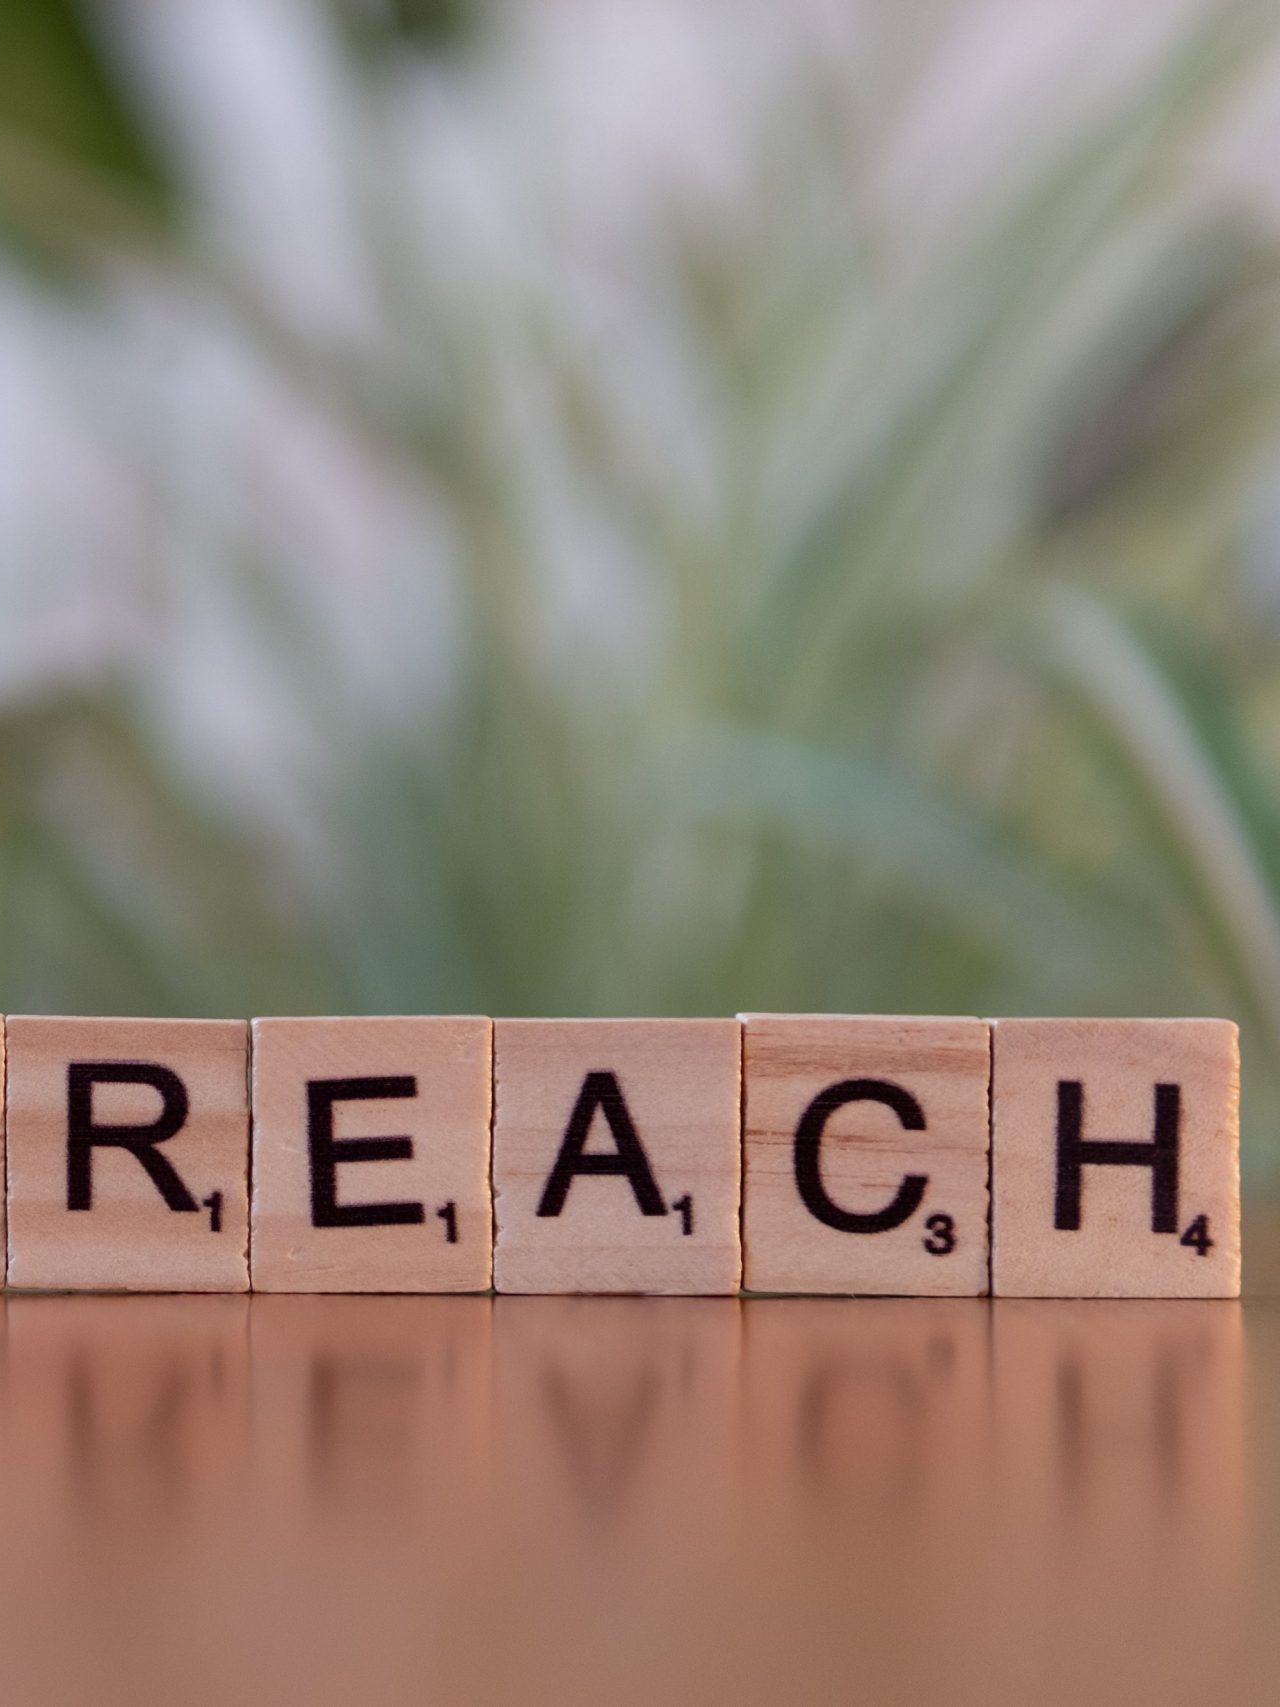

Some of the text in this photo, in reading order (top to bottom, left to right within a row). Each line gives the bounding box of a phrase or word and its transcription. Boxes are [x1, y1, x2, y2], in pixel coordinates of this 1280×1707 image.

[202, 1190, 224, 1233] 1
[436, 1202, 459, 1244] 1
[671, 1194, 694, 1236] 1
[924, 1213, 956, 1256] 3
[1180, 1214, 1215, 1257] 4
